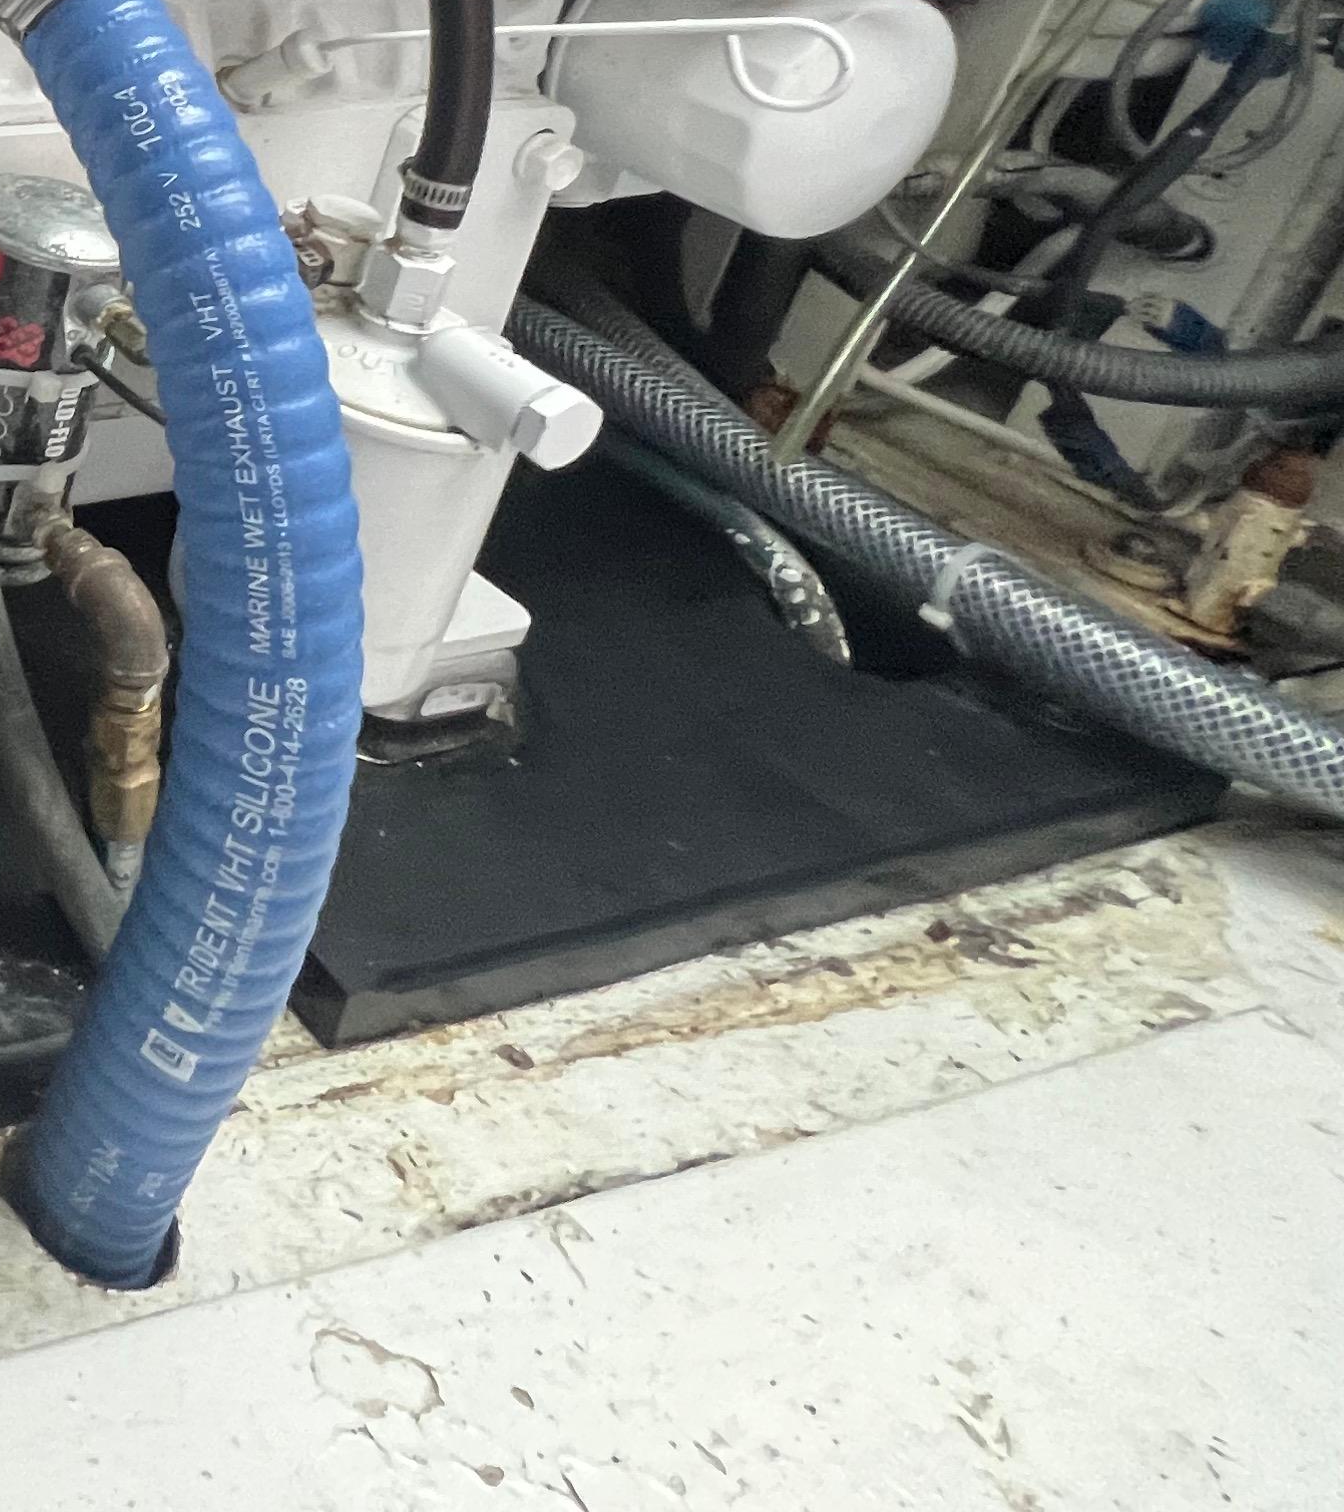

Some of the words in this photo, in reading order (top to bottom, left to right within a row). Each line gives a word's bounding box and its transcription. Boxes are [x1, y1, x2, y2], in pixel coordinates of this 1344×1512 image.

[167, 191, 202, 231] 252
[190, 292, 223, 340] VHT
[45, 387, 82, 458] OLD-FLO
[212, 365, 258, 484] EXHAUST
[238, 493, 265, 548] WET
[266, 463, 288, 526] LLOYDS
[244, 556, 272, 654] MARINE
[231, 678, 281, 833] SILICONE
[268, 678, 307, 837] 1-800-414-2628
[214, 833, 257, 891] VHT
[174, 891, 239, 998] TRIDENT
